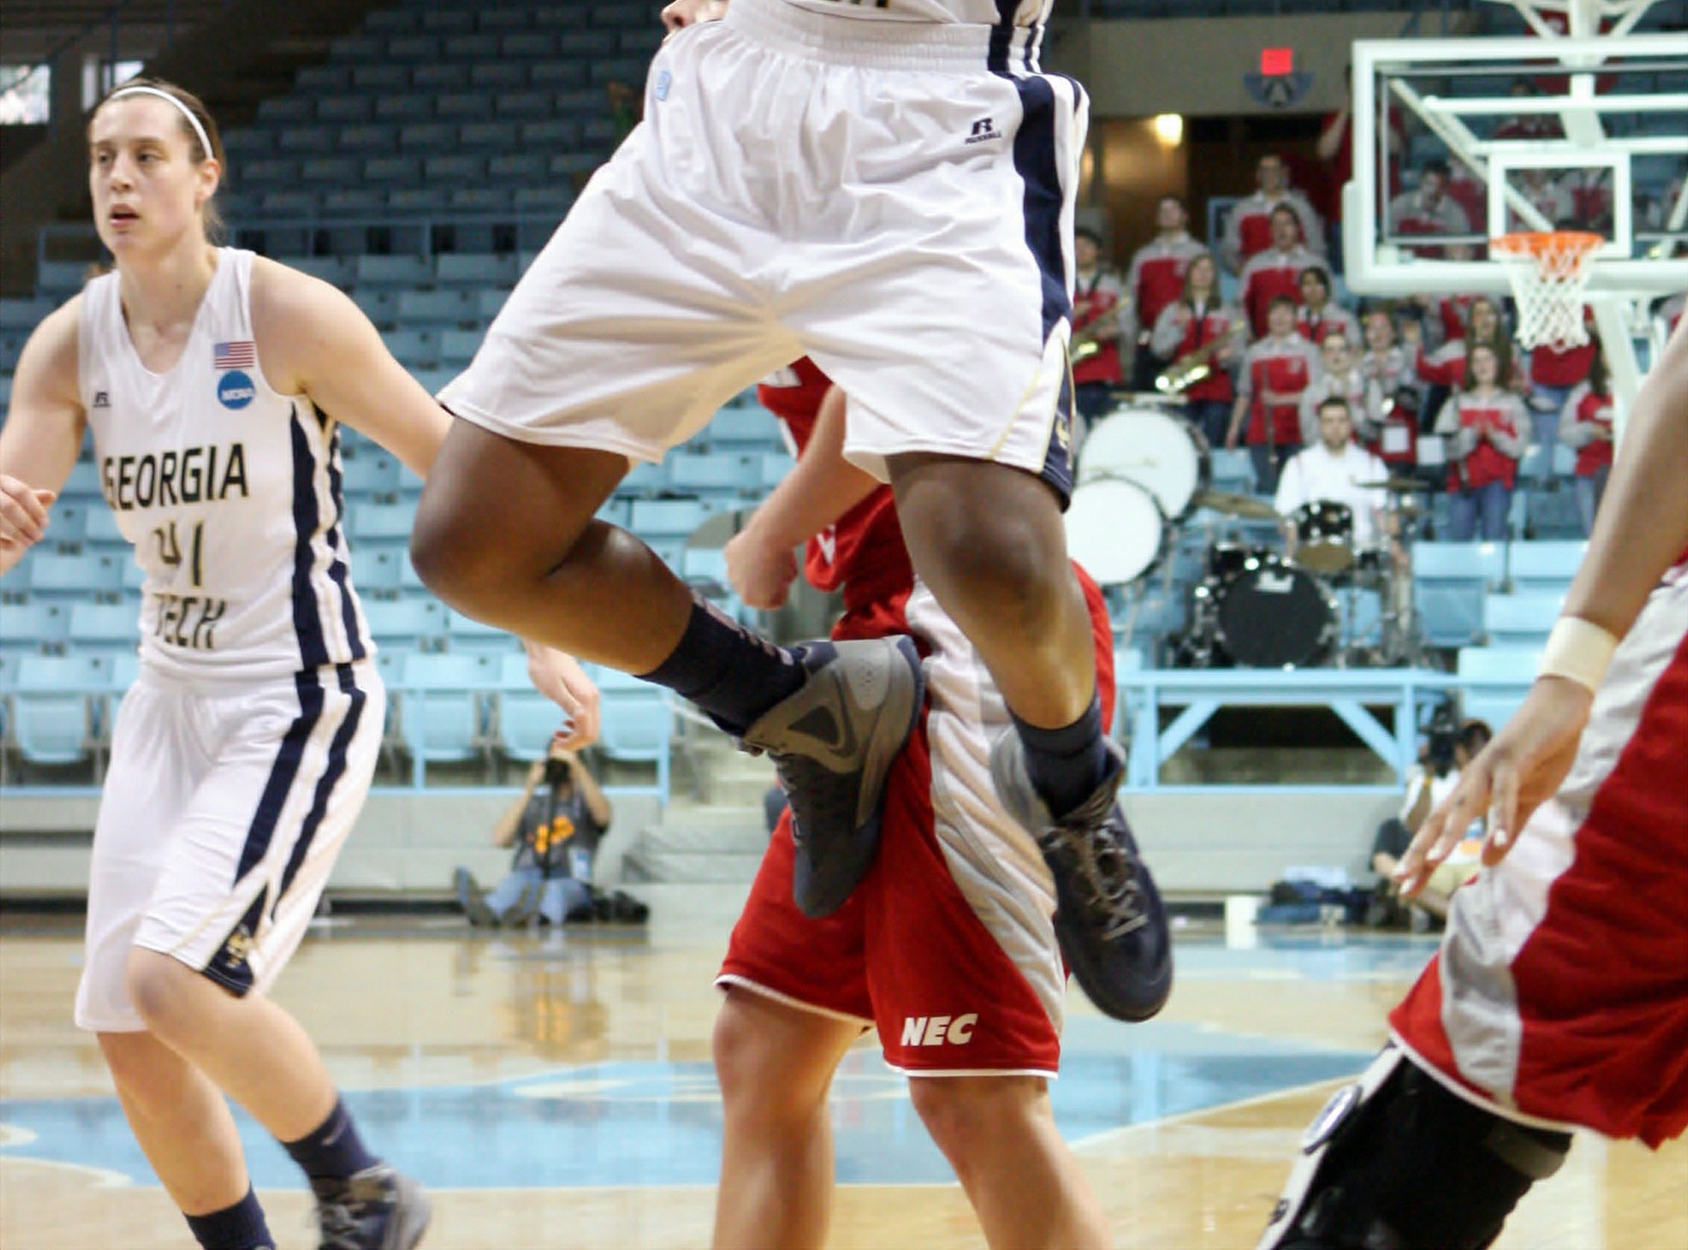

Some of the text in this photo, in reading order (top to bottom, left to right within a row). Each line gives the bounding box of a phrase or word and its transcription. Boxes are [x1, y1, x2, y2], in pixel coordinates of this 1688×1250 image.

[104, 442, 250, 512] GEORGIA
[153, 519, 205, 588] 41
[152, 593, 227, 649] TECH
[901, 1013, 978, 1046] NEC
